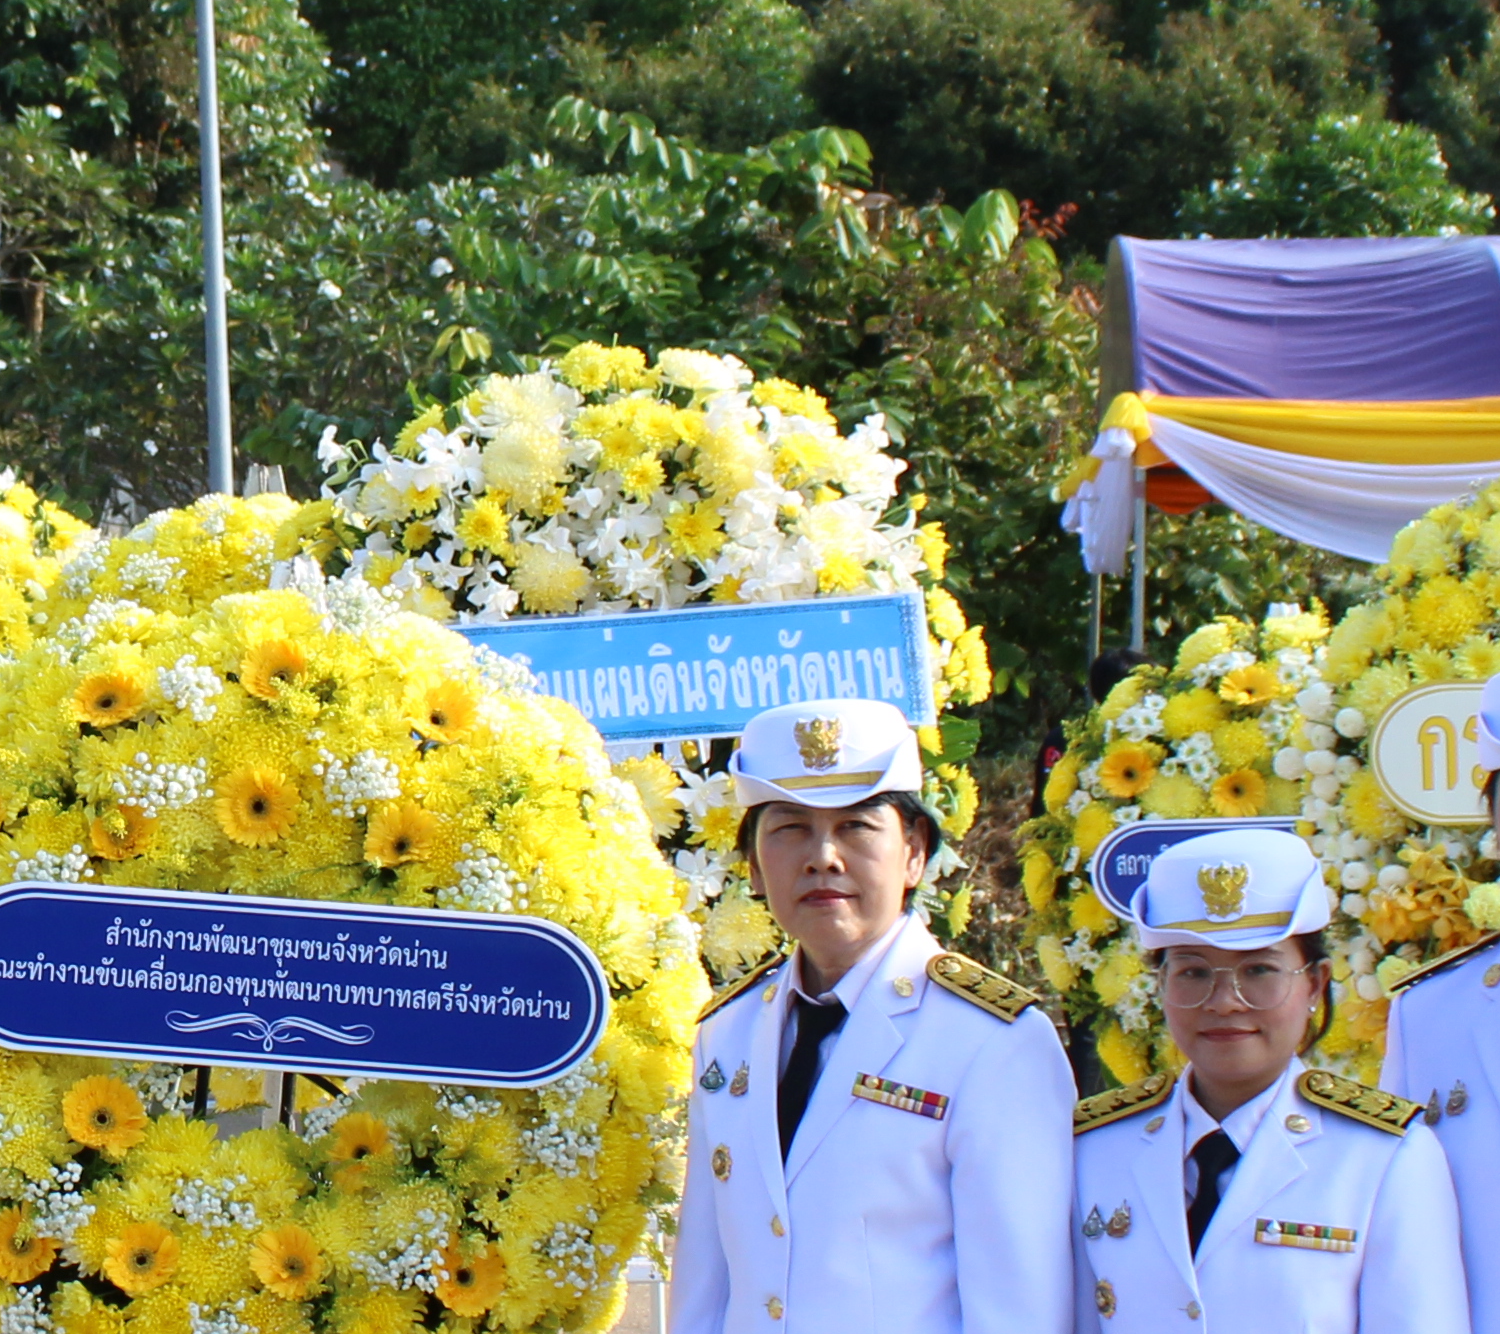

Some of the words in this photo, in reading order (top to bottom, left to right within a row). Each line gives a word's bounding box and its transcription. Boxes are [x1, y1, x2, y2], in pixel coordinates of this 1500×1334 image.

[105, 916, 448, 970] สำนักงานพัฒนาชุมชนจังหวัดน่าน
